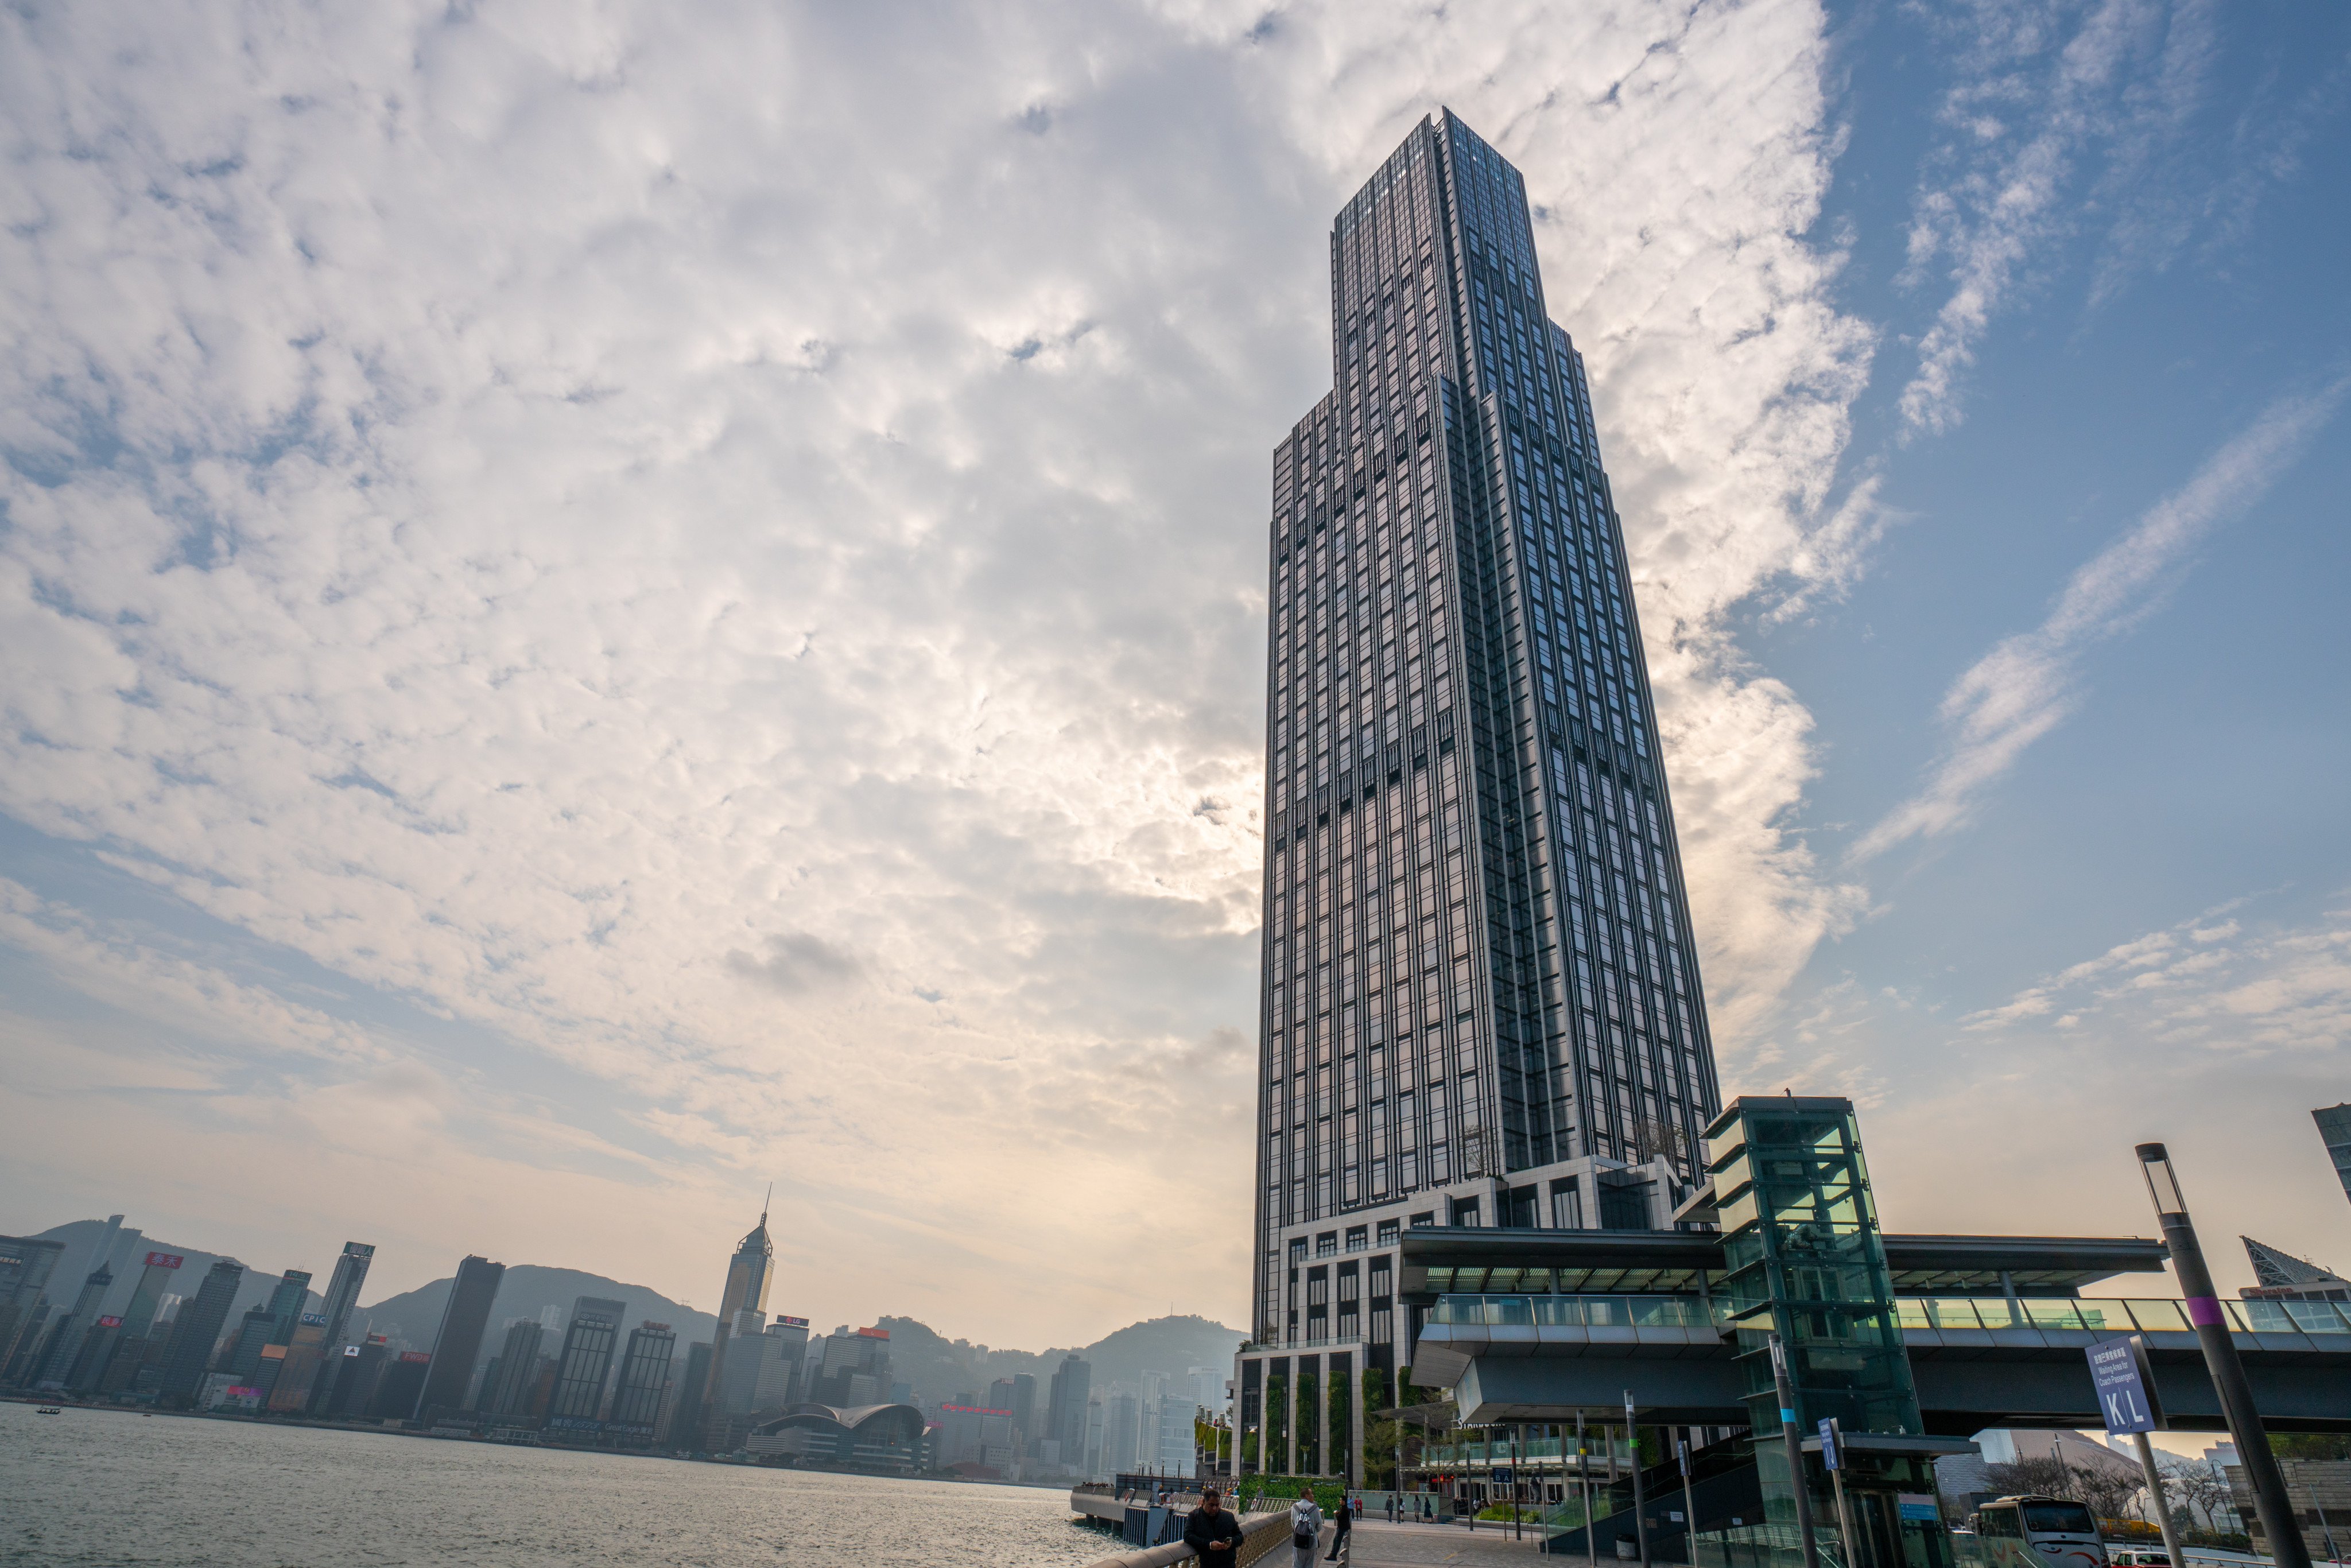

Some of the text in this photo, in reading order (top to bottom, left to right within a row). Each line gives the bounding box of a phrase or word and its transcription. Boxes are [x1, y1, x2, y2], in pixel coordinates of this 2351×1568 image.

[152, 1253, 178, 1267] 泰禾
[2249, 1287, 2294, 1296] Sheraton
[303, 1314, 326, 1324] CPIC
[405, 1352, 422, 1360] FWD
[2098, 1364, 2113, 1375] Waiting
[2112, 1363, 2122, 1372] Area
[2099, 1372, 2135, 1387] Coach Passengers
[2106, 1390, 2144, 1426] K L
[573, 1420, 600, 1429] 1573
[605, 1423, 622, 1431] Great
[622, 1425, 639, 1434] Eagle
[1830, 1446, 1834, 1465] J
